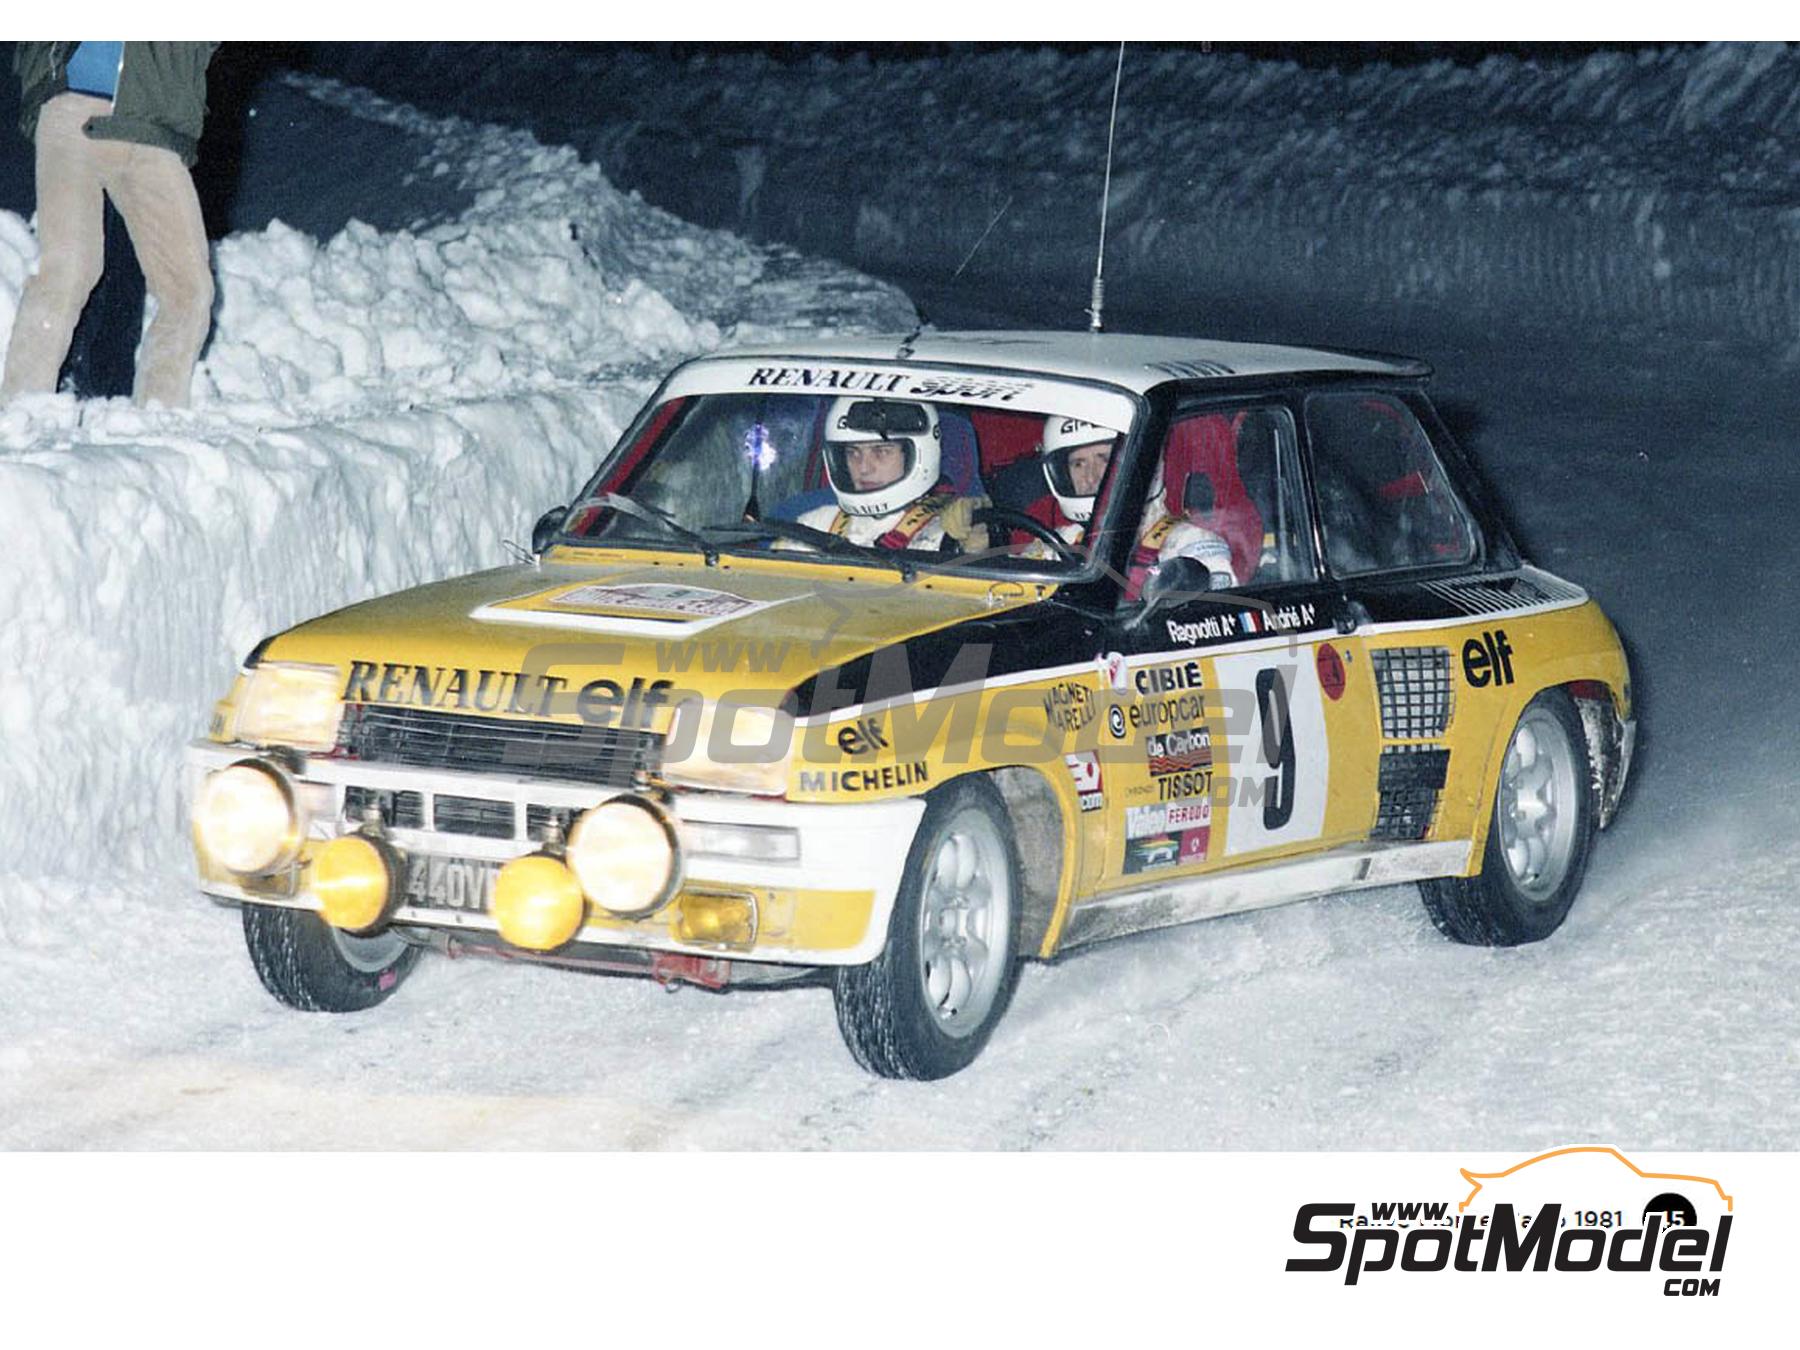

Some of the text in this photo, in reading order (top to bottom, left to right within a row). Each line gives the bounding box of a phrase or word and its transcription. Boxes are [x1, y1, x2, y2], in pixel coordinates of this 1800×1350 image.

[749, 367, 910, 392] RENAULT
[1166, 615, 1220, 645] Ragnotti
[1462, 629, 1514, 687] elf
[342, 660, 676, 732] RENAULT elf
[1129, 694, 1205, 729] europcar
[838, 718, 888, 754] elf
[1166, 732, 1211, 755] Carbon
[1255, 667, 1296, 830] 9
[799, 760, 929, 791] MICHELIN
[1158, 771, 1213, 800] TISSOT
[1168, 804, 1210, 824] FERODO
